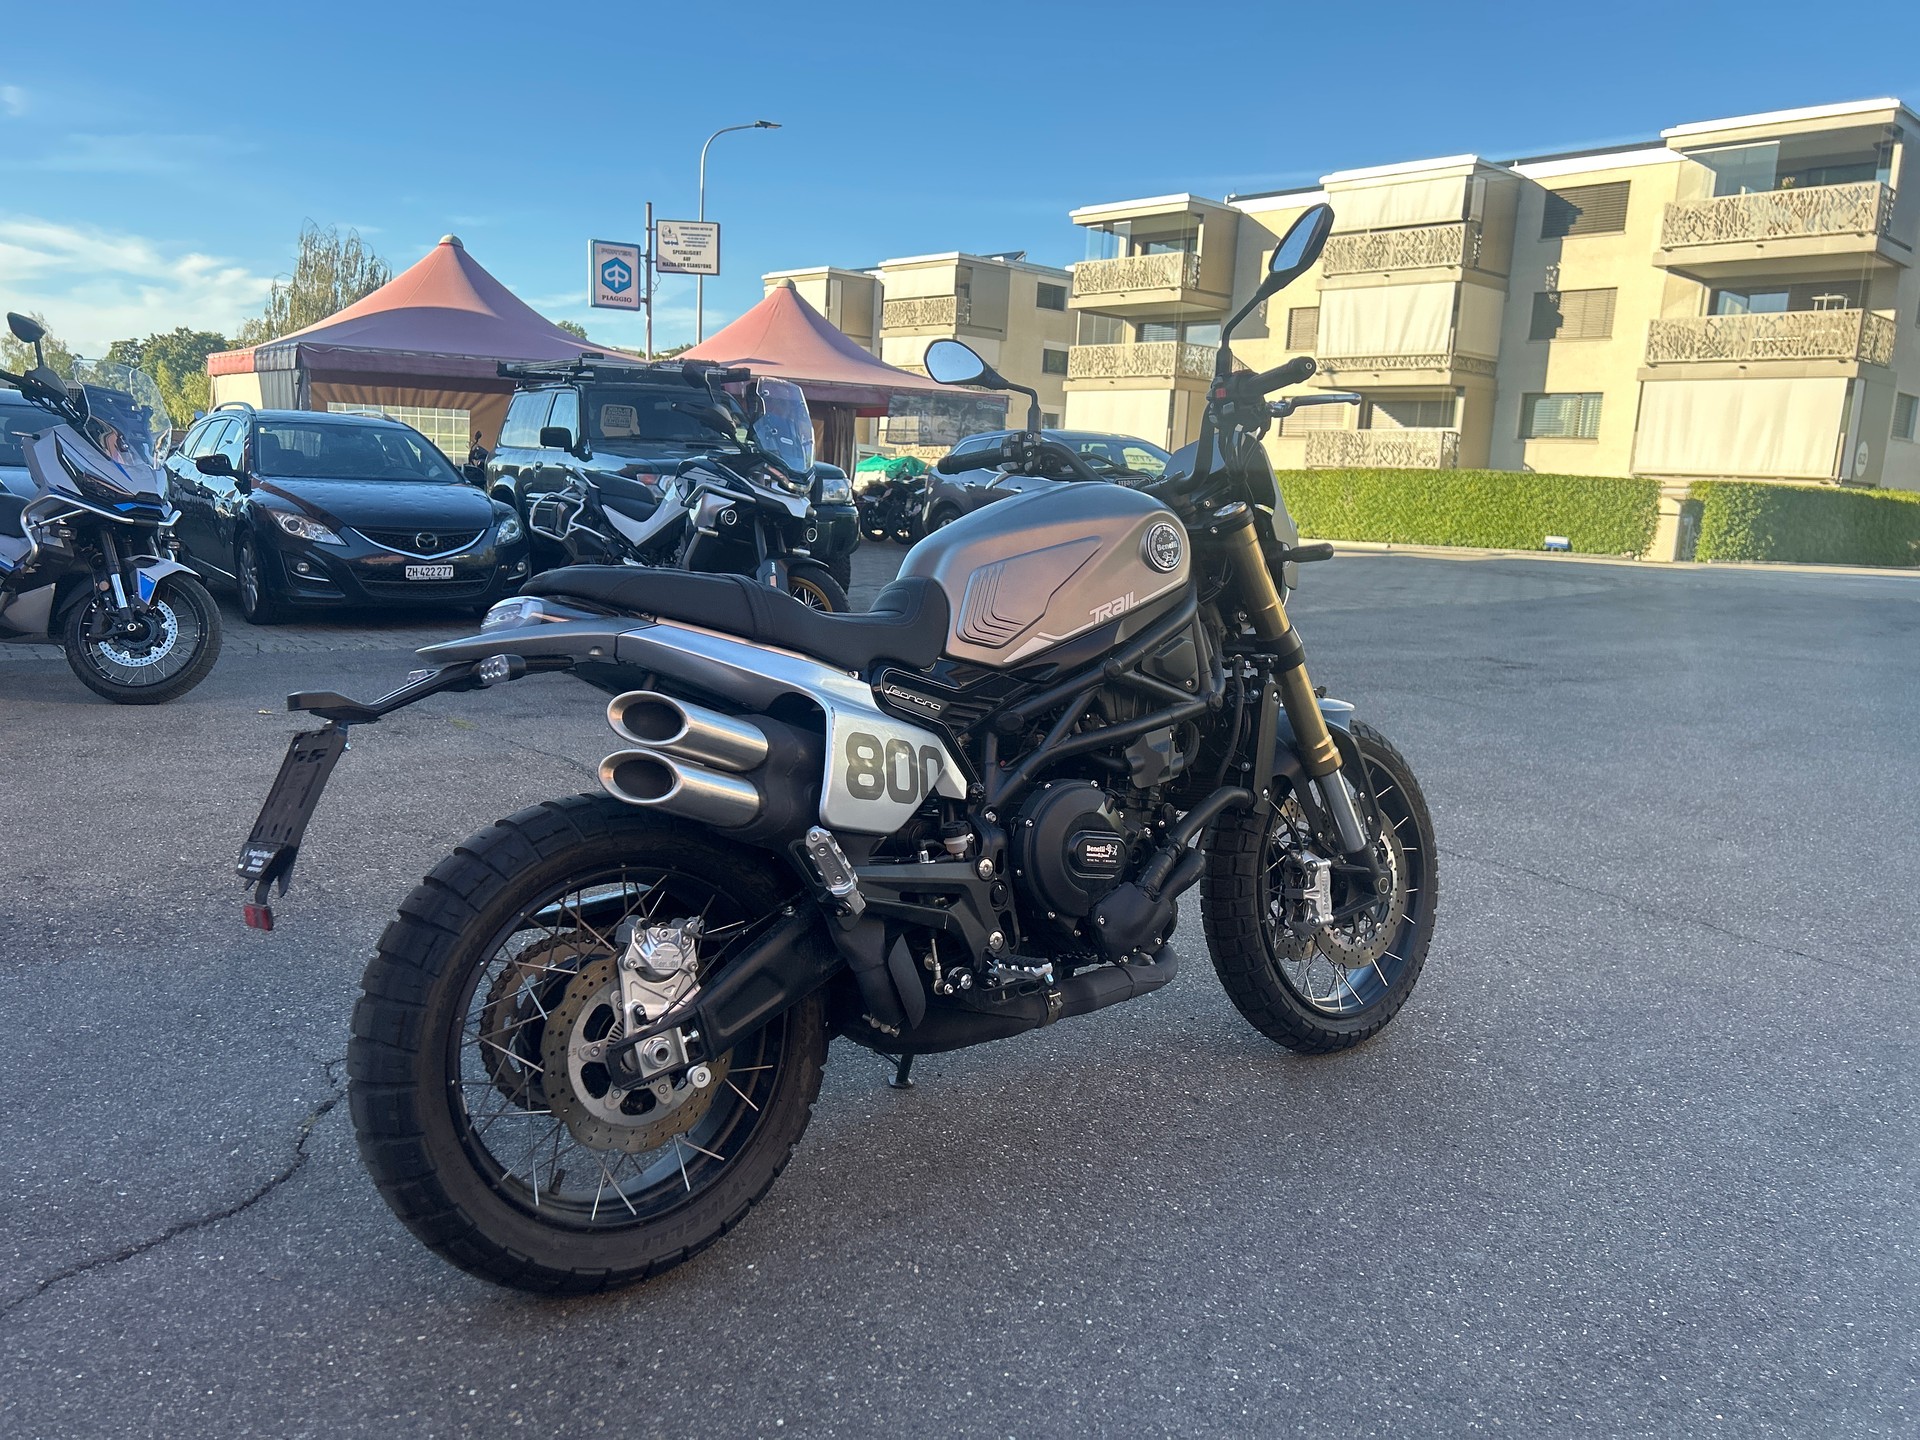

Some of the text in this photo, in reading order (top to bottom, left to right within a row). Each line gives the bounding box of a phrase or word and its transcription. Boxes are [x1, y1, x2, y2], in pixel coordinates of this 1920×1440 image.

[601, 294, 632, 303] PIAGGIO
[1156, 540, 1178, 552] Benelli
[407, 567, 418, 577] ZH
[1086, 844, 1106, 853] Benelli
